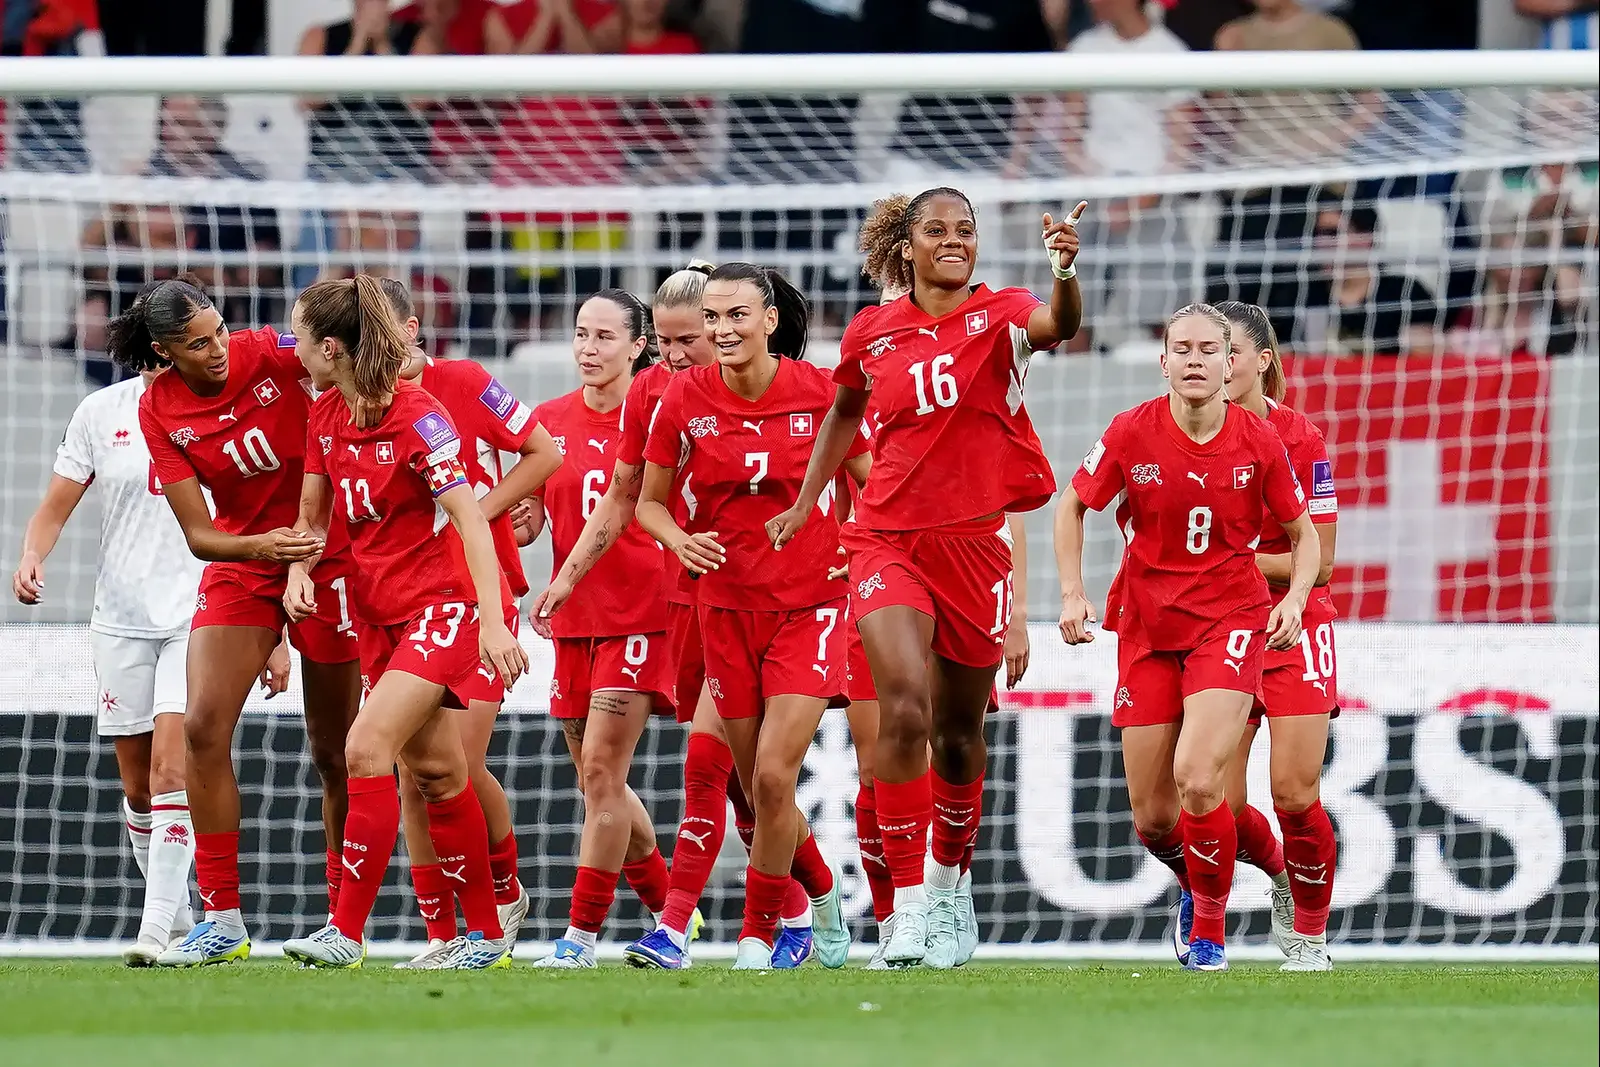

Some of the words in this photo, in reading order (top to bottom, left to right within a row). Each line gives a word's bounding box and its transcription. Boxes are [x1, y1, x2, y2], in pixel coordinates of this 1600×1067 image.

[908, 353, 959, 416] 16
[222, 426, 281, 479] 10
[745, 452, 770, 495] 7
[339, 478, 382, 524] 13
[582, 469, 605, 521] 6
[1186, 506, 1213, 555] 8
[330, 577, 353, 633] 1
[409, 602, 466, 648] 13
[815, 608, 838, 661] 7
[1299, 623, 1334, 682] 18
[1001, 687, 1567, 917] UBS
